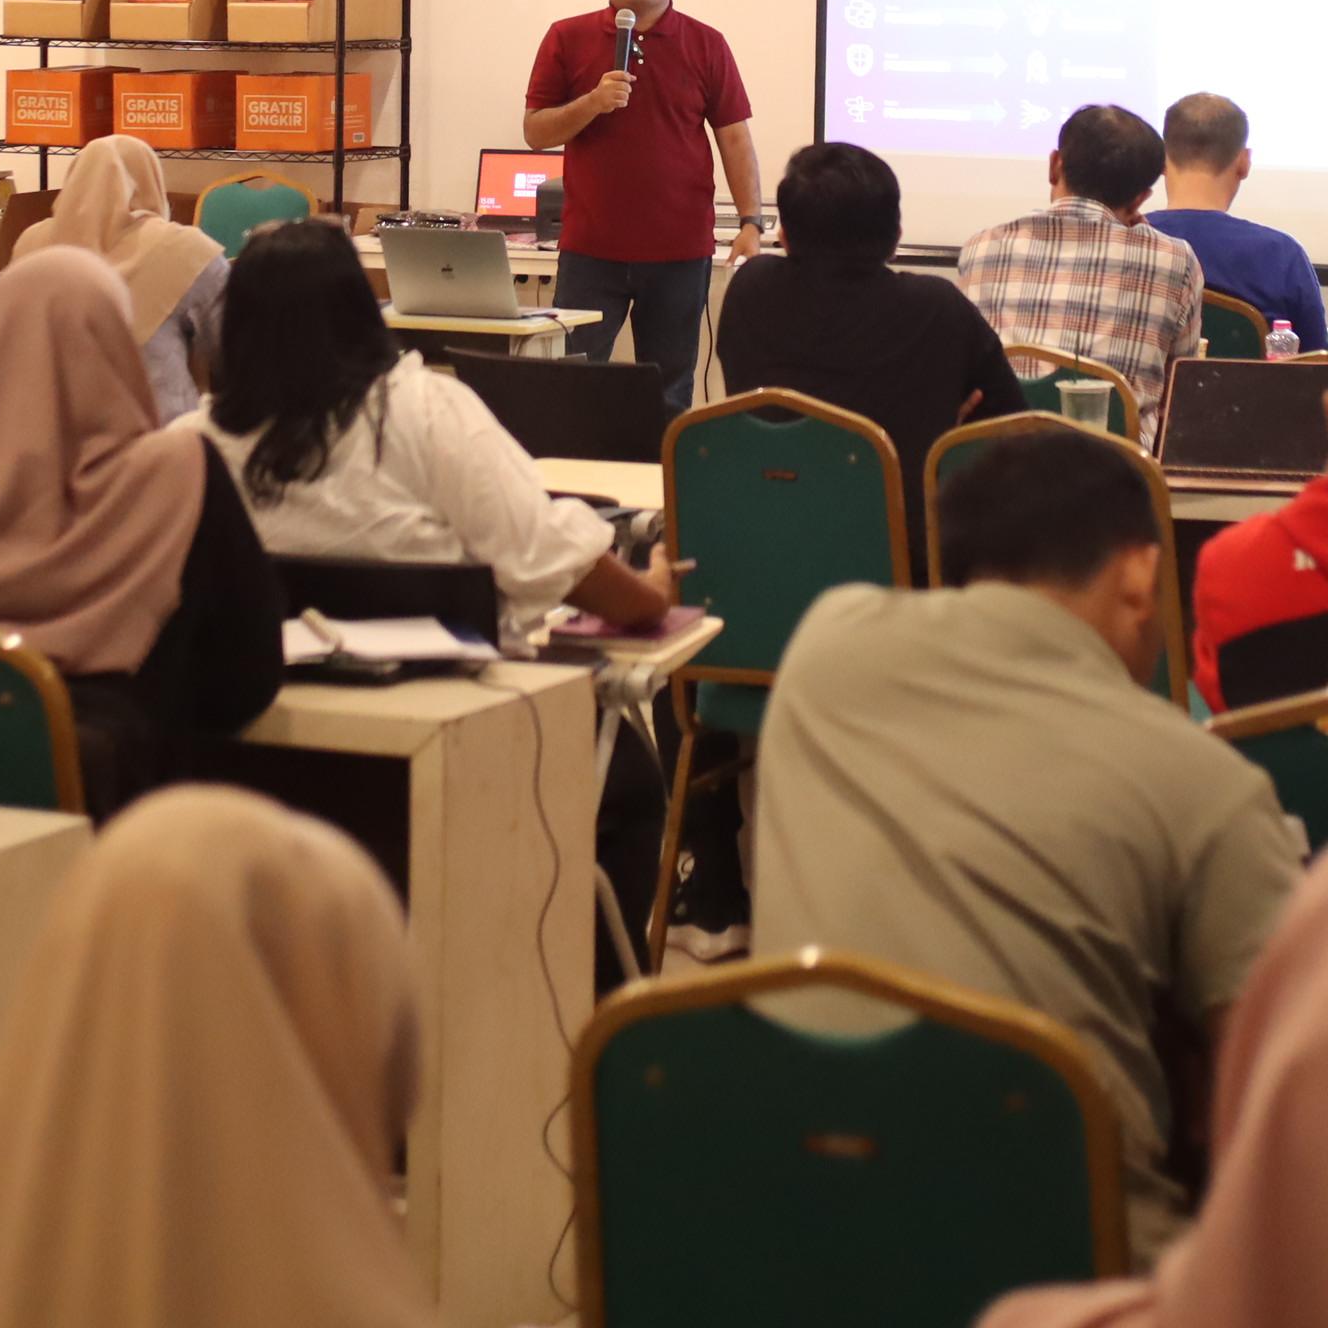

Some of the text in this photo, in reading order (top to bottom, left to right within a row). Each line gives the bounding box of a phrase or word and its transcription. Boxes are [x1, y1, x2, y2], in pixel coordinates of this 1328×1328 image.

[17, 95, 68, 110] GRATIS
[126, 98, 179, 112] GRATIS
[248, 100, 303, 114] GRATIS
[16, 108, 68, 122] ONGKIR
[126, 111, 179, 124] ONGKIR
[248, 113, 303, 127] ONGKIR
